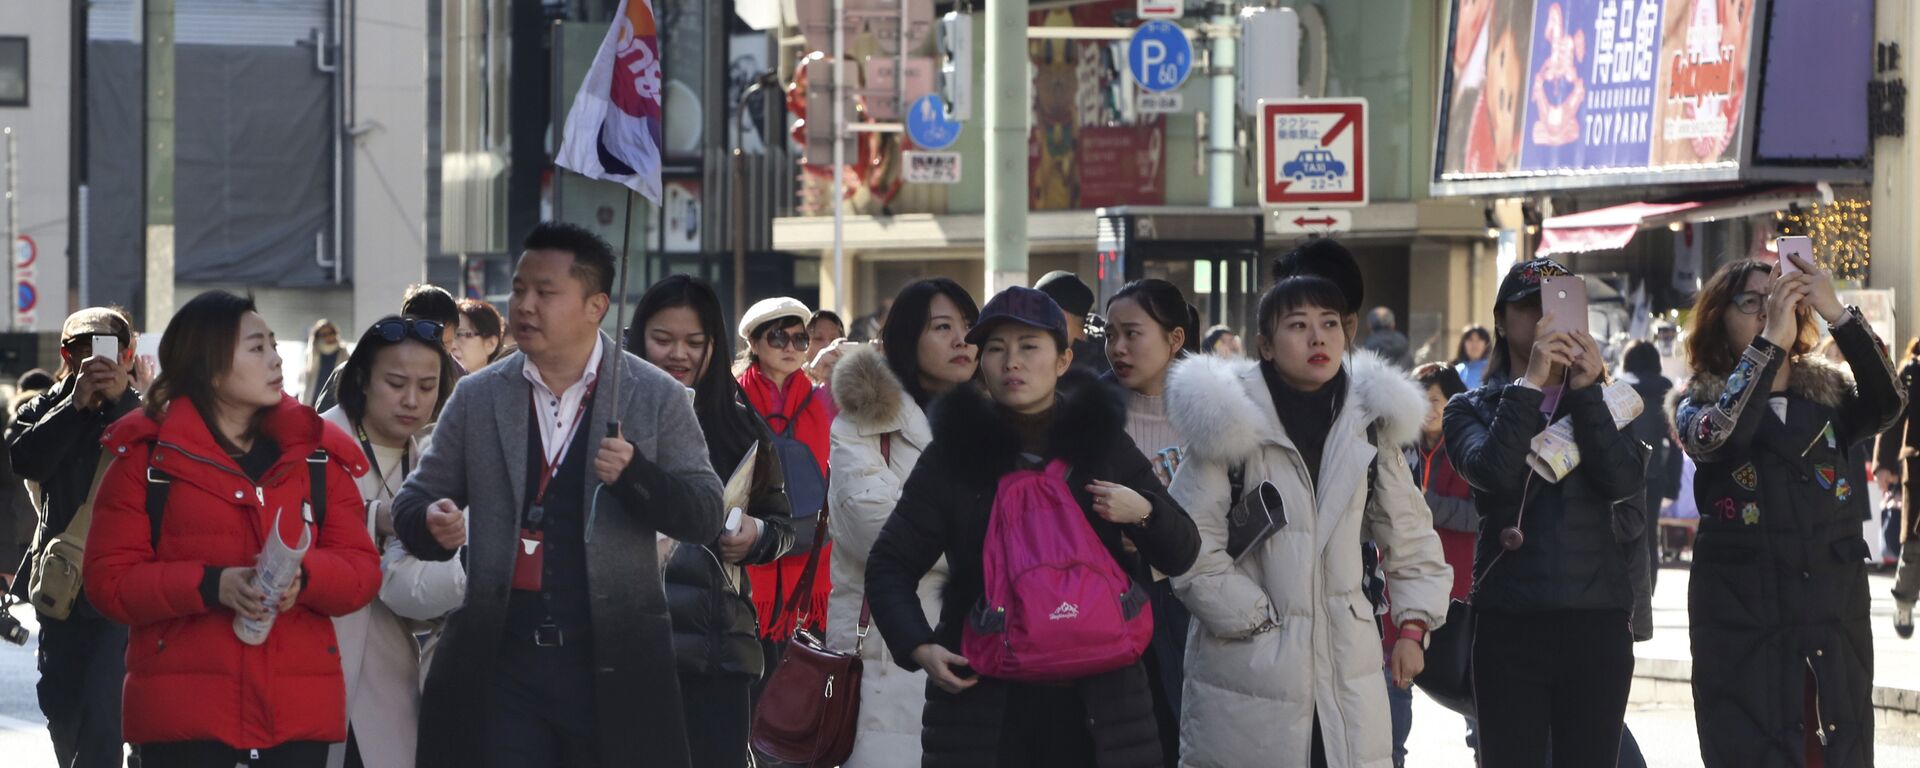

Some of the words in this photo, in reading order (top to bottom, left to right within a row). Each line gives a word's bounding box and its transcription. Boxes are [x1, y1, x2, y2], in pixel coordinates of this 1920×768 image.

[1591, 0, 1658, 84] 博品館
[1141, 39, 1167, 84] P
[1158, 64, 1178, 84] 60
[1279, 117, 1319, 127] タクシー
[1585, 113, 1613, 146] TOY
[1613, 111, 1649, 145] PARK
[1304, 161, 1326, 172] TAXI
[1311, 179, 1343, 190] 22-1
